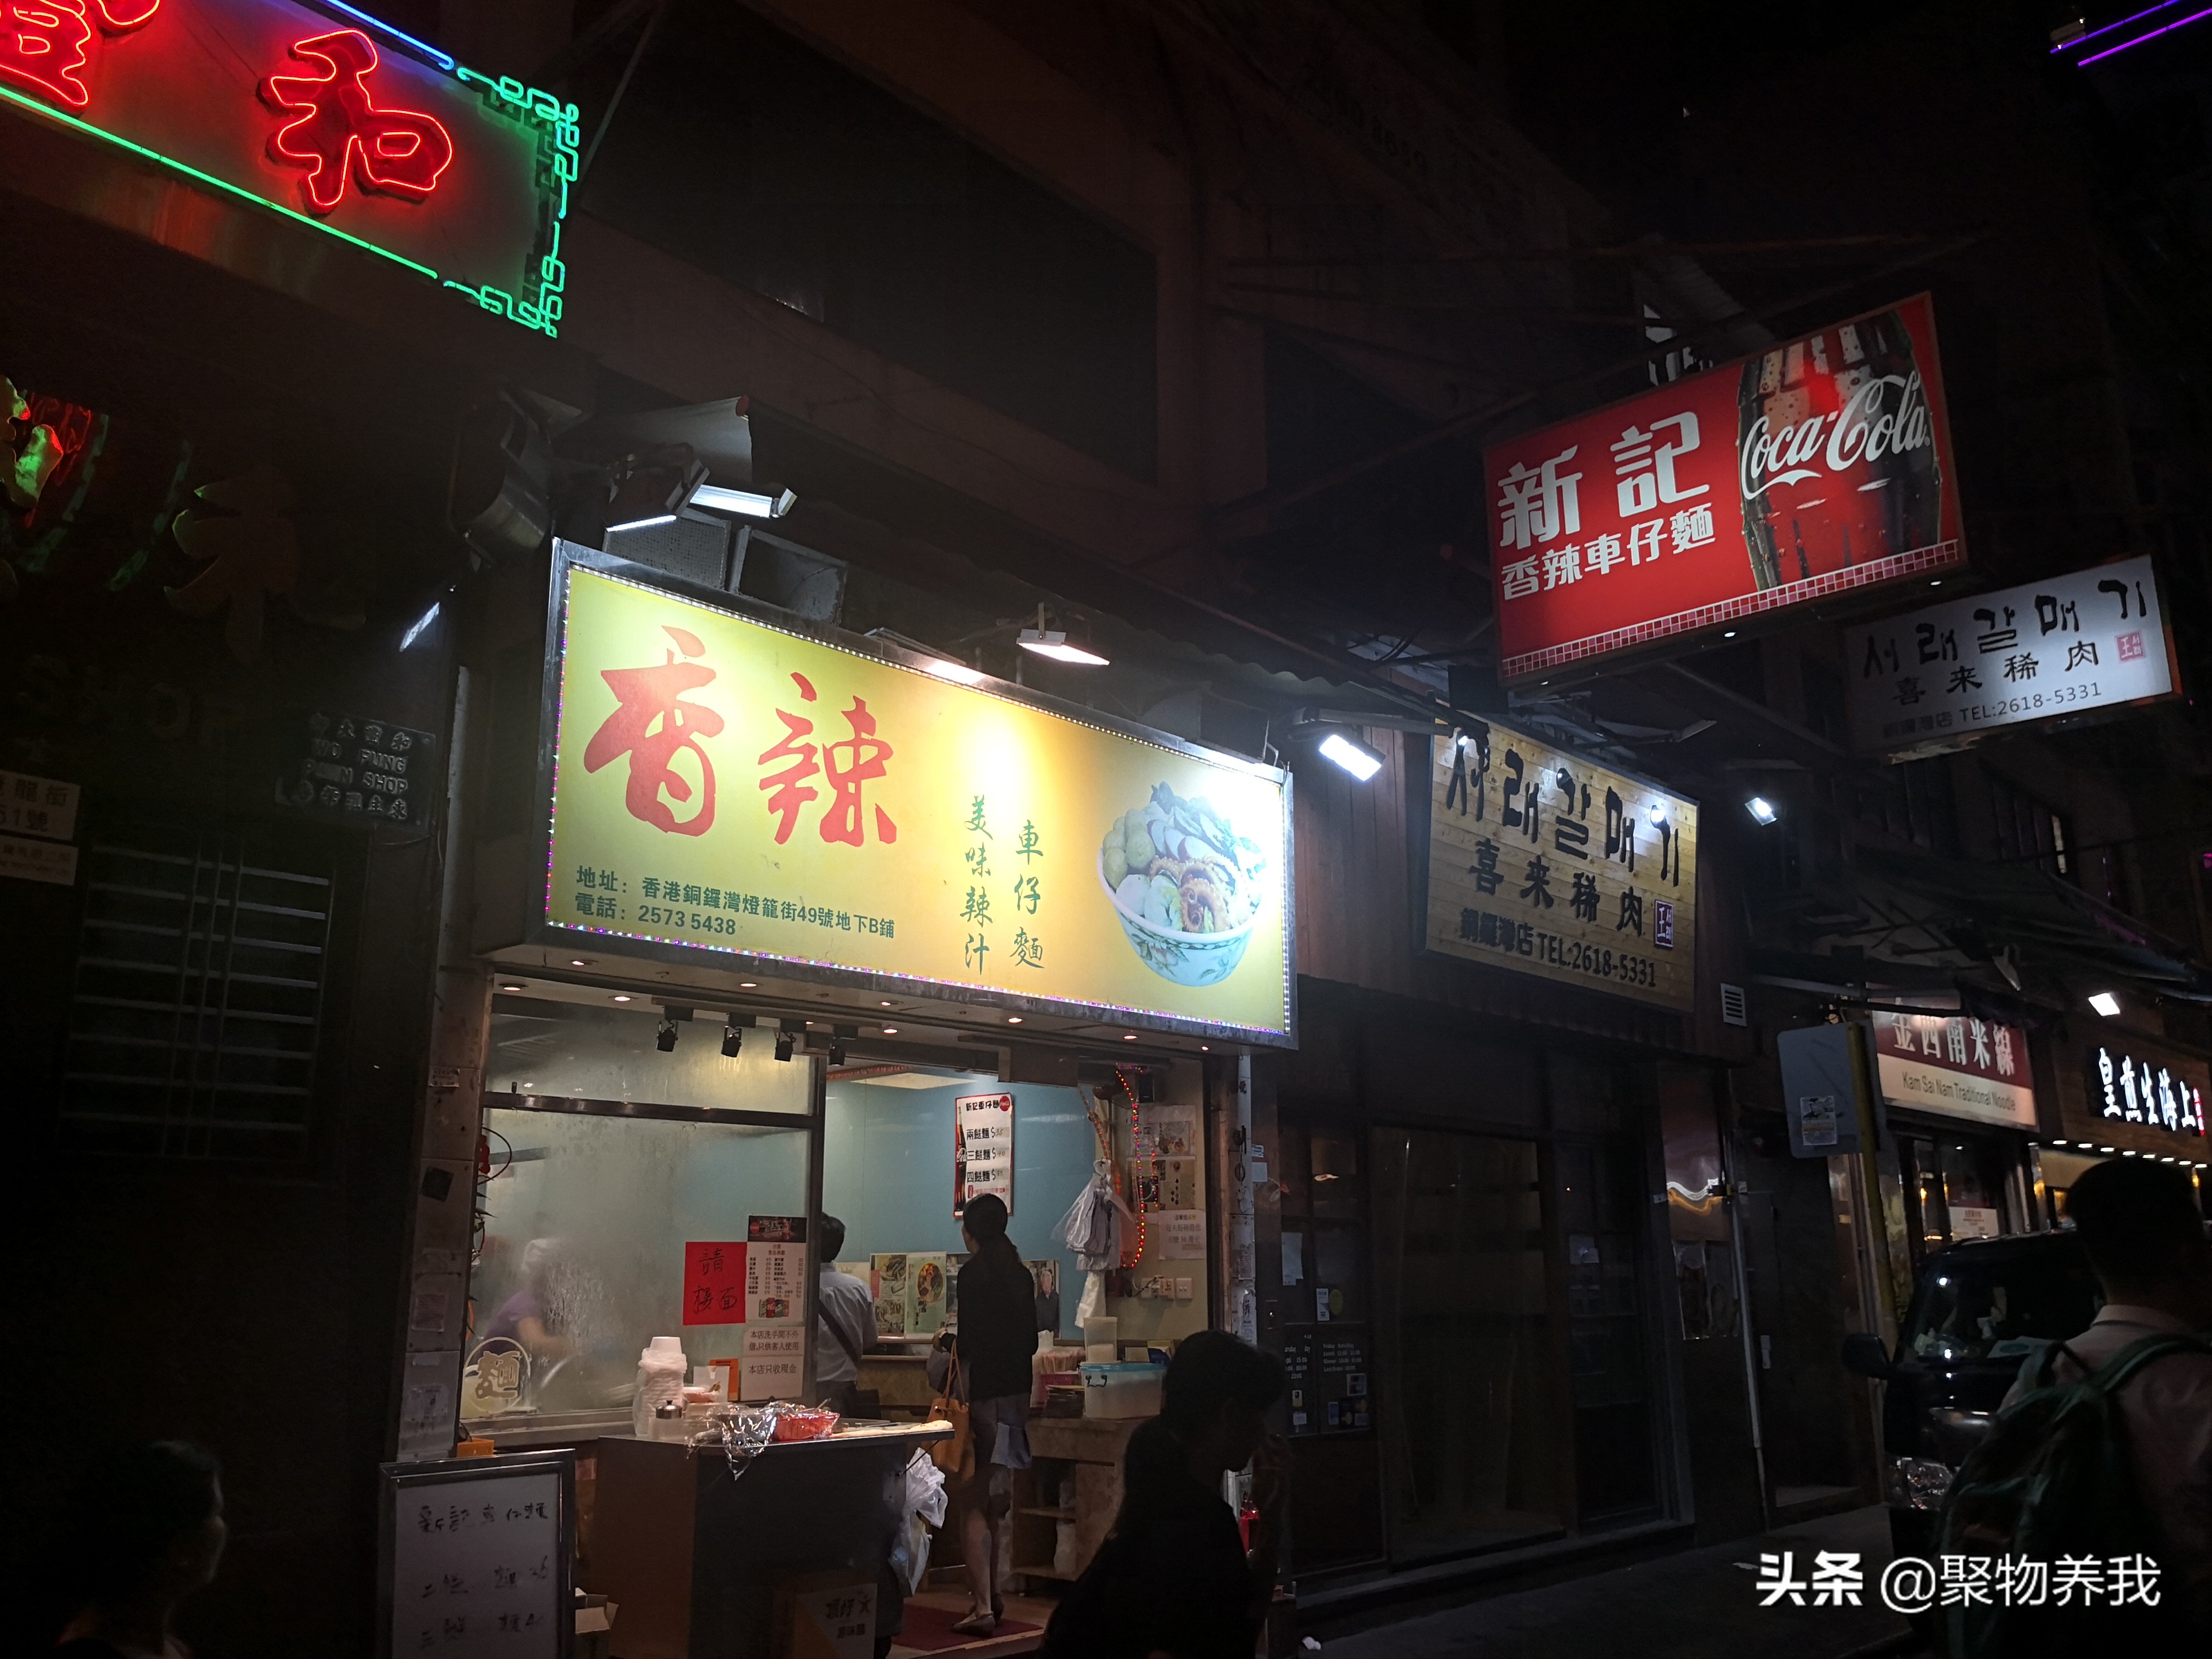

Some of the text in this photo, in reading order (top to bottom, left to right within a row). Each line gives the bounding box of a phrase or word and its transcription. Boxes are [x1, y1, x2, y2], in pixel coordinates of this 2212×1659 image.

[1740, 370, 1928, 499] Coca-Cola
[1498, 411, 1710, 550] 新記
[1501, 503, 1715, 601] 香辣車仔麵
[1863, 579, 2147, 678] 서래갈매기
[1959, 682, 2102, 723] TEL:2618-5331
[359, 748, 408, 774] FUNG
[584, 625, 897, 847] 香辣
[363, 770, 408, 794] SHOP
[960, 795, 993, 975] 美味辣汁
[1010, 819, 1045, 969] 車仔麵
[638, 905, 685, 927] 2573
[691, 913, 736, 935] 5438
[1539, 933, 1656, 988] TEL:2618-5331
[1902, 1071, 1920, 1090] Kam
[1922, 1075, 1935, 1093] Sai
[1936, 1079, 1953, 1098] Nam
[1954, 1083, 1991, 1106] Traditional
[751, 1330, 798, 1339] 本店洗手間不外
[476, 1351, 520, 1400] 麵
[749, 1364, 797, 1374] 本店只收現金
